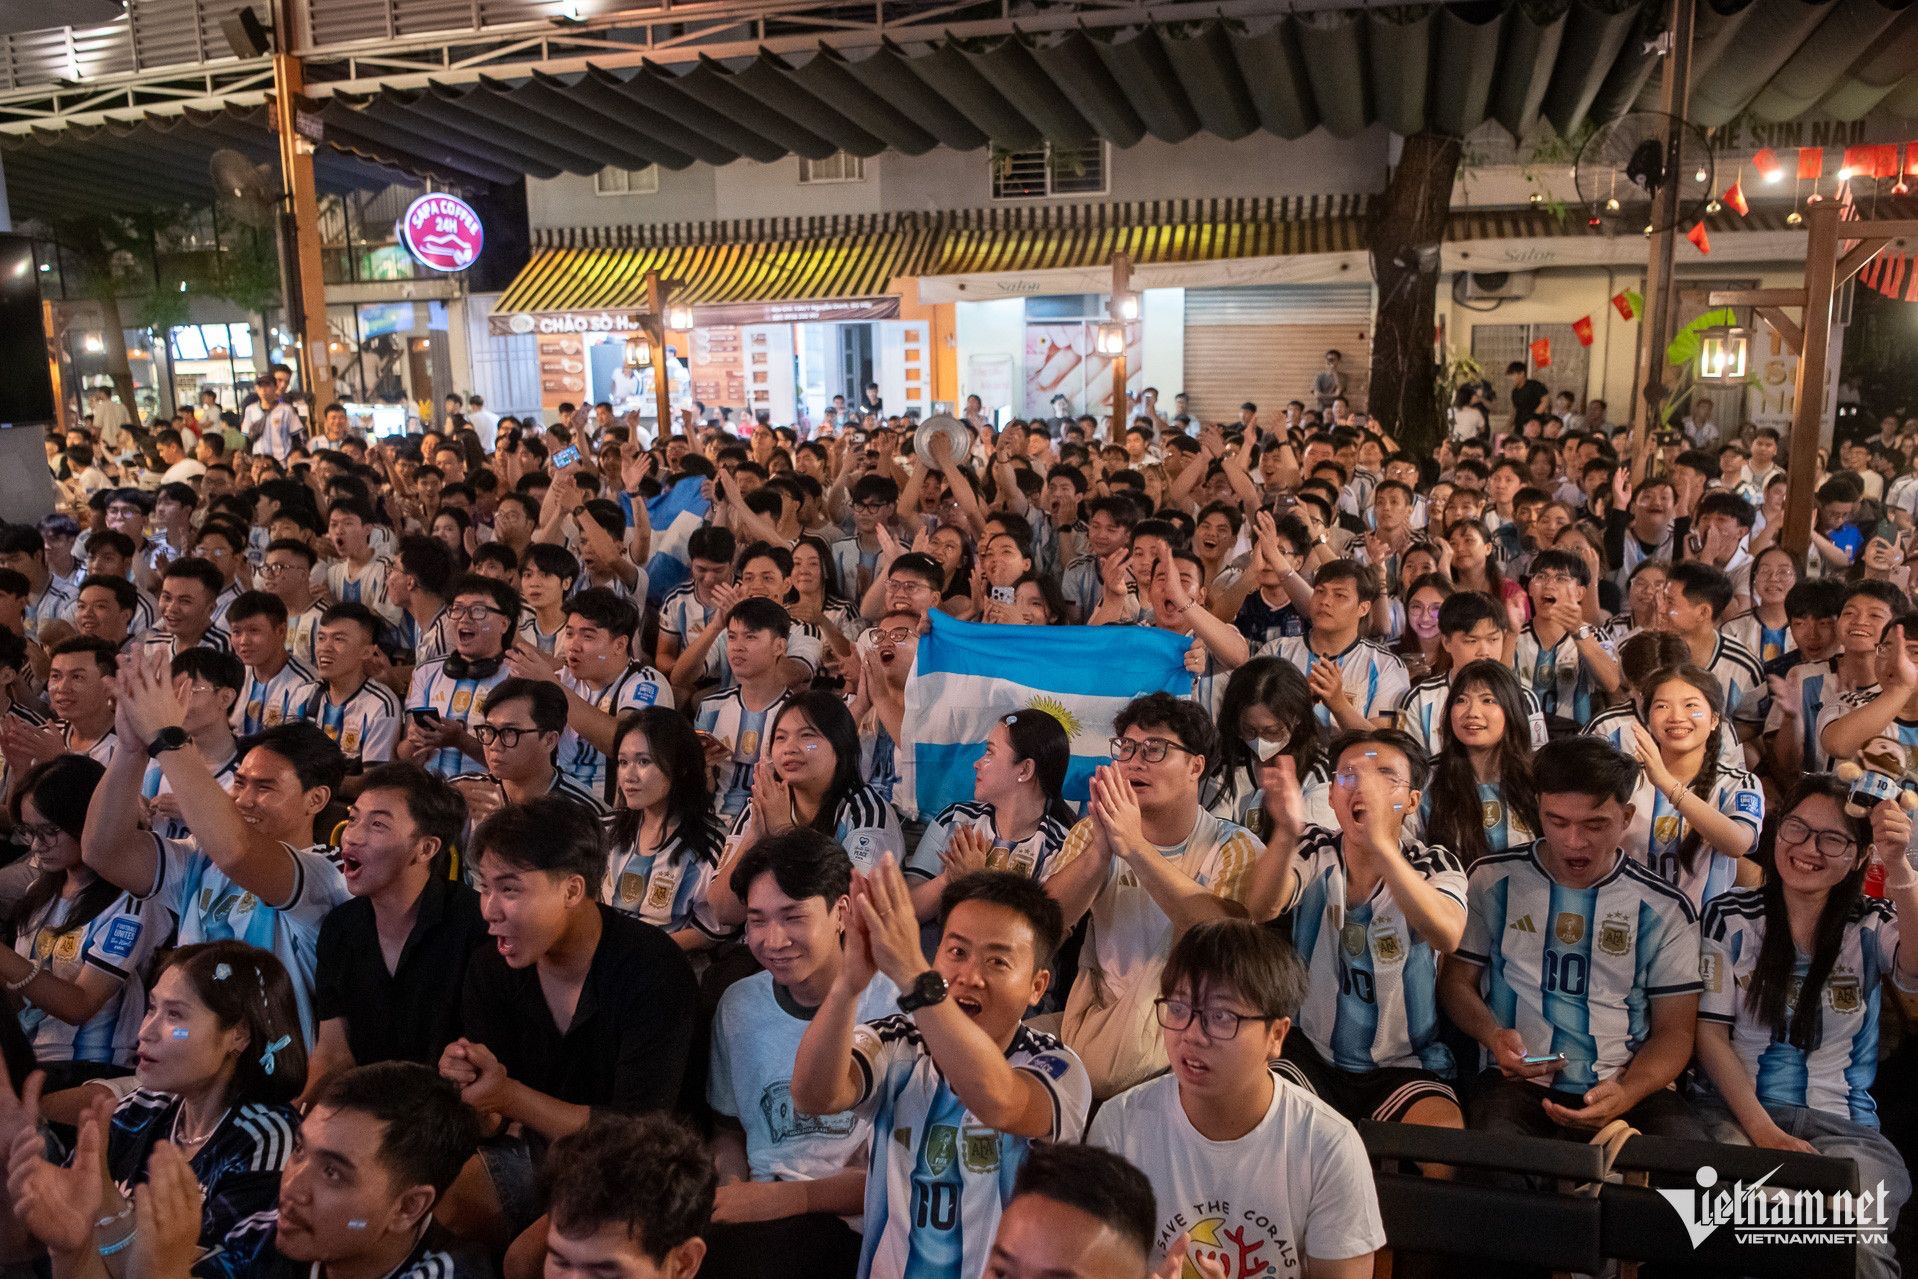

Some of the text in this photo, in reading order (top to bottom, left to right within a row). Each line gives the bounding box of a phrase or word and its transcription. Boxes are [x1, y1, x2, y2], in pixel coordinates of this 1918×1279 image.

[411, 199, 480, 236] SAPA COFFEE
[435, 215, 458, 234] 24H
[997, 280, 1040, 292] Salon
[539, 313, 588, 333] CHÁO
[1877, 779, 1888, 791] 10
[114, 929, 136, 941] UNITES
[1545, 949, 1587, 996] 10
[972, 1138, 994, 1159] AFA
[914, 1178, 959, 1231] 10
[1157, 1200, 1297, 1268] SAVE THE CORALS
